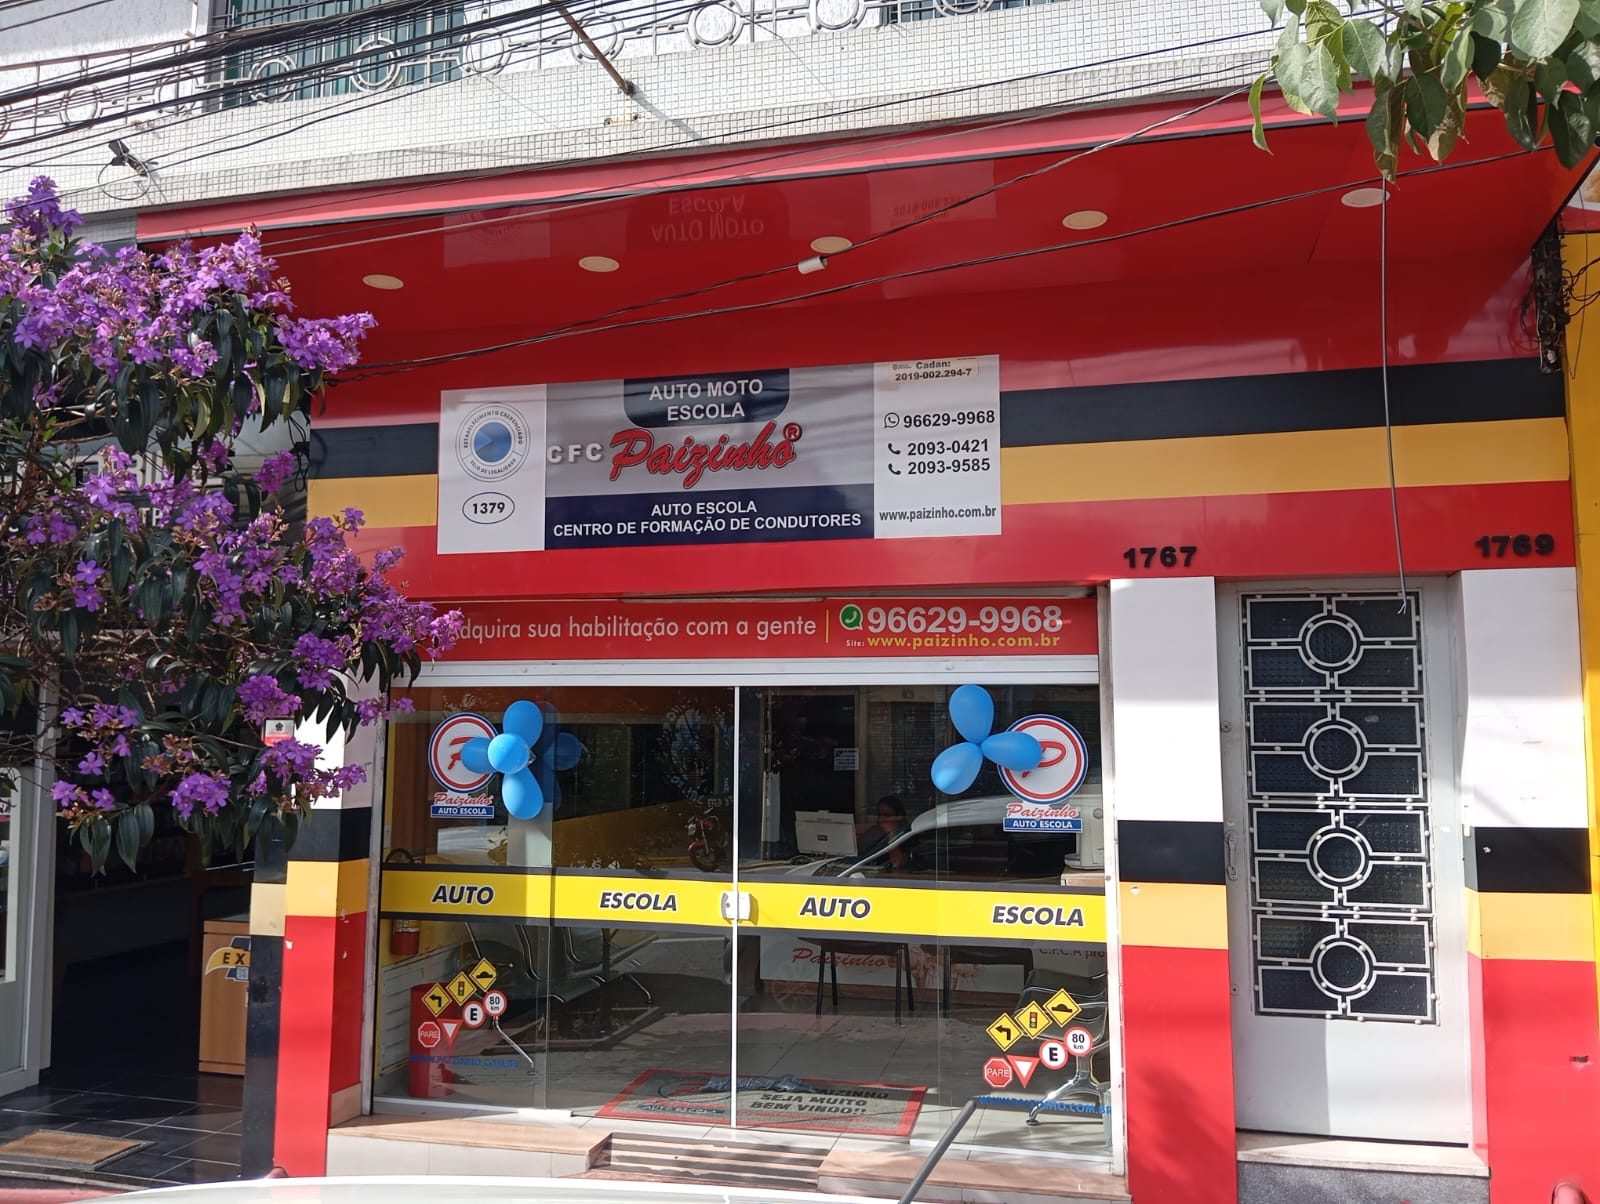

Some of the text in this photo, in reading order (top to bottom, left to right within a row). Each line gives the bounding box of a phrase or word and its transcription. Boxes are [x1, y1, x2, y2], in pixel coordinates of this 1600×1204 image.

[916, 361, 951, 370] Cadan:
[896, 368, 972, 381] 2019-002.294-7
[649, 379, 763, 401] AUTO MOTO
[667, 402, 745, 421] ESCOLA
[903, 410, 995, 428] 96629-9968
[907, 439, 989, 456] 2093-0421
[908, 458, 990, 475] 2093-9585
[472, 503, 505, 515] 1379
[651, 501, 757, 516] AUTO ESCOLA
[879, 505, 996, 523] www.paizinho.com.br
[553, 514, 861, 536] CENTRO DE FORMAÇÃO DE CONDUTORES
[1475, 534, 1555, 557] 1769
[1123, 546, 1197, 568] 1767
[528, 622, 561, 637] sua
[569, 616, 679, 641] habilitação
[686, 619, 728, 635] com
[736, 622, 748, 635] a
[756, 615, 816, 640] gente
[867, 606, 1062, 634] 96629-9968
[846, 633, 1060, 650] Site: www.paizinho.com.br
[1008, 804, 1079, 819] Paizinho
[1013, 820, 1073, 829] AUTO ESCOLA
[432, 885, 677, 912] AUTO ESCOLA
[800, 897, 1085, 928] AUTO ESCOLA
[489, 996, 500, 1005] 80
[470, 1008, 477, 1021] E
[1072, 1034, 1085, 1044] 80
[1049, 1047, 1058, 1061] E
[986, 1068, 1010, 1077] PARE
[751, 1102, 791, 1111] BEM
[761, 1094, 867, 1107] SEJA MUITO
